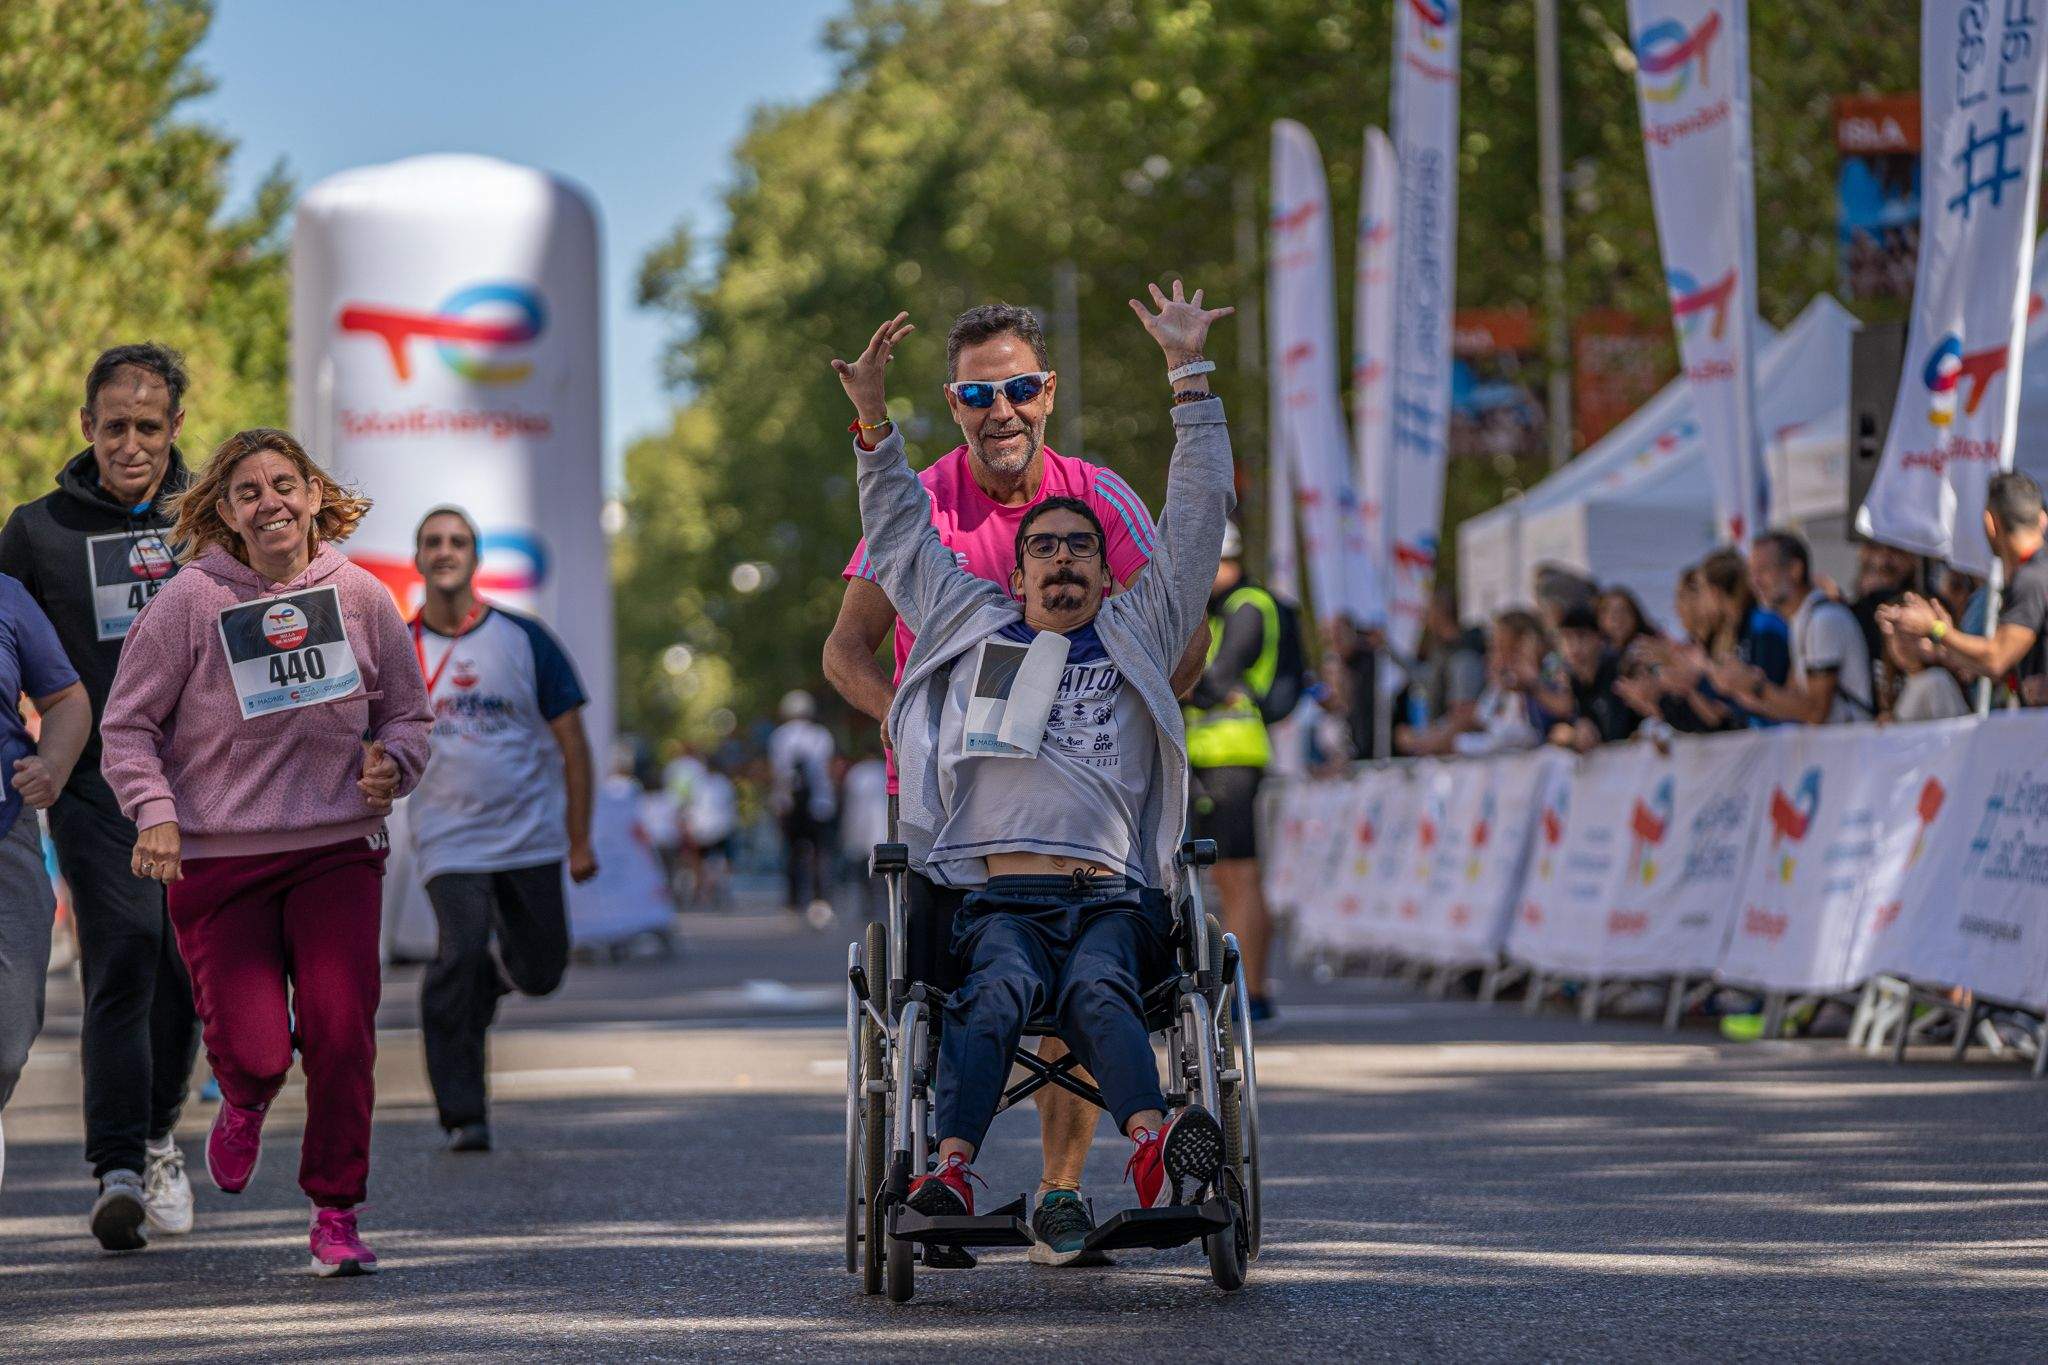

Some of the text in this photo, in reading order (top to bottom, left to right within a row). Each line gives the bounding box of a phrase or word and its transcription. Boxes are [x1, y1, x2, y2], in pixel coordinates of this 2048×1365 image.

[269, 646, 327, 687] 440
[257, 695, 285, 705] MADRID
[1093, 741, 1114, 751] one
